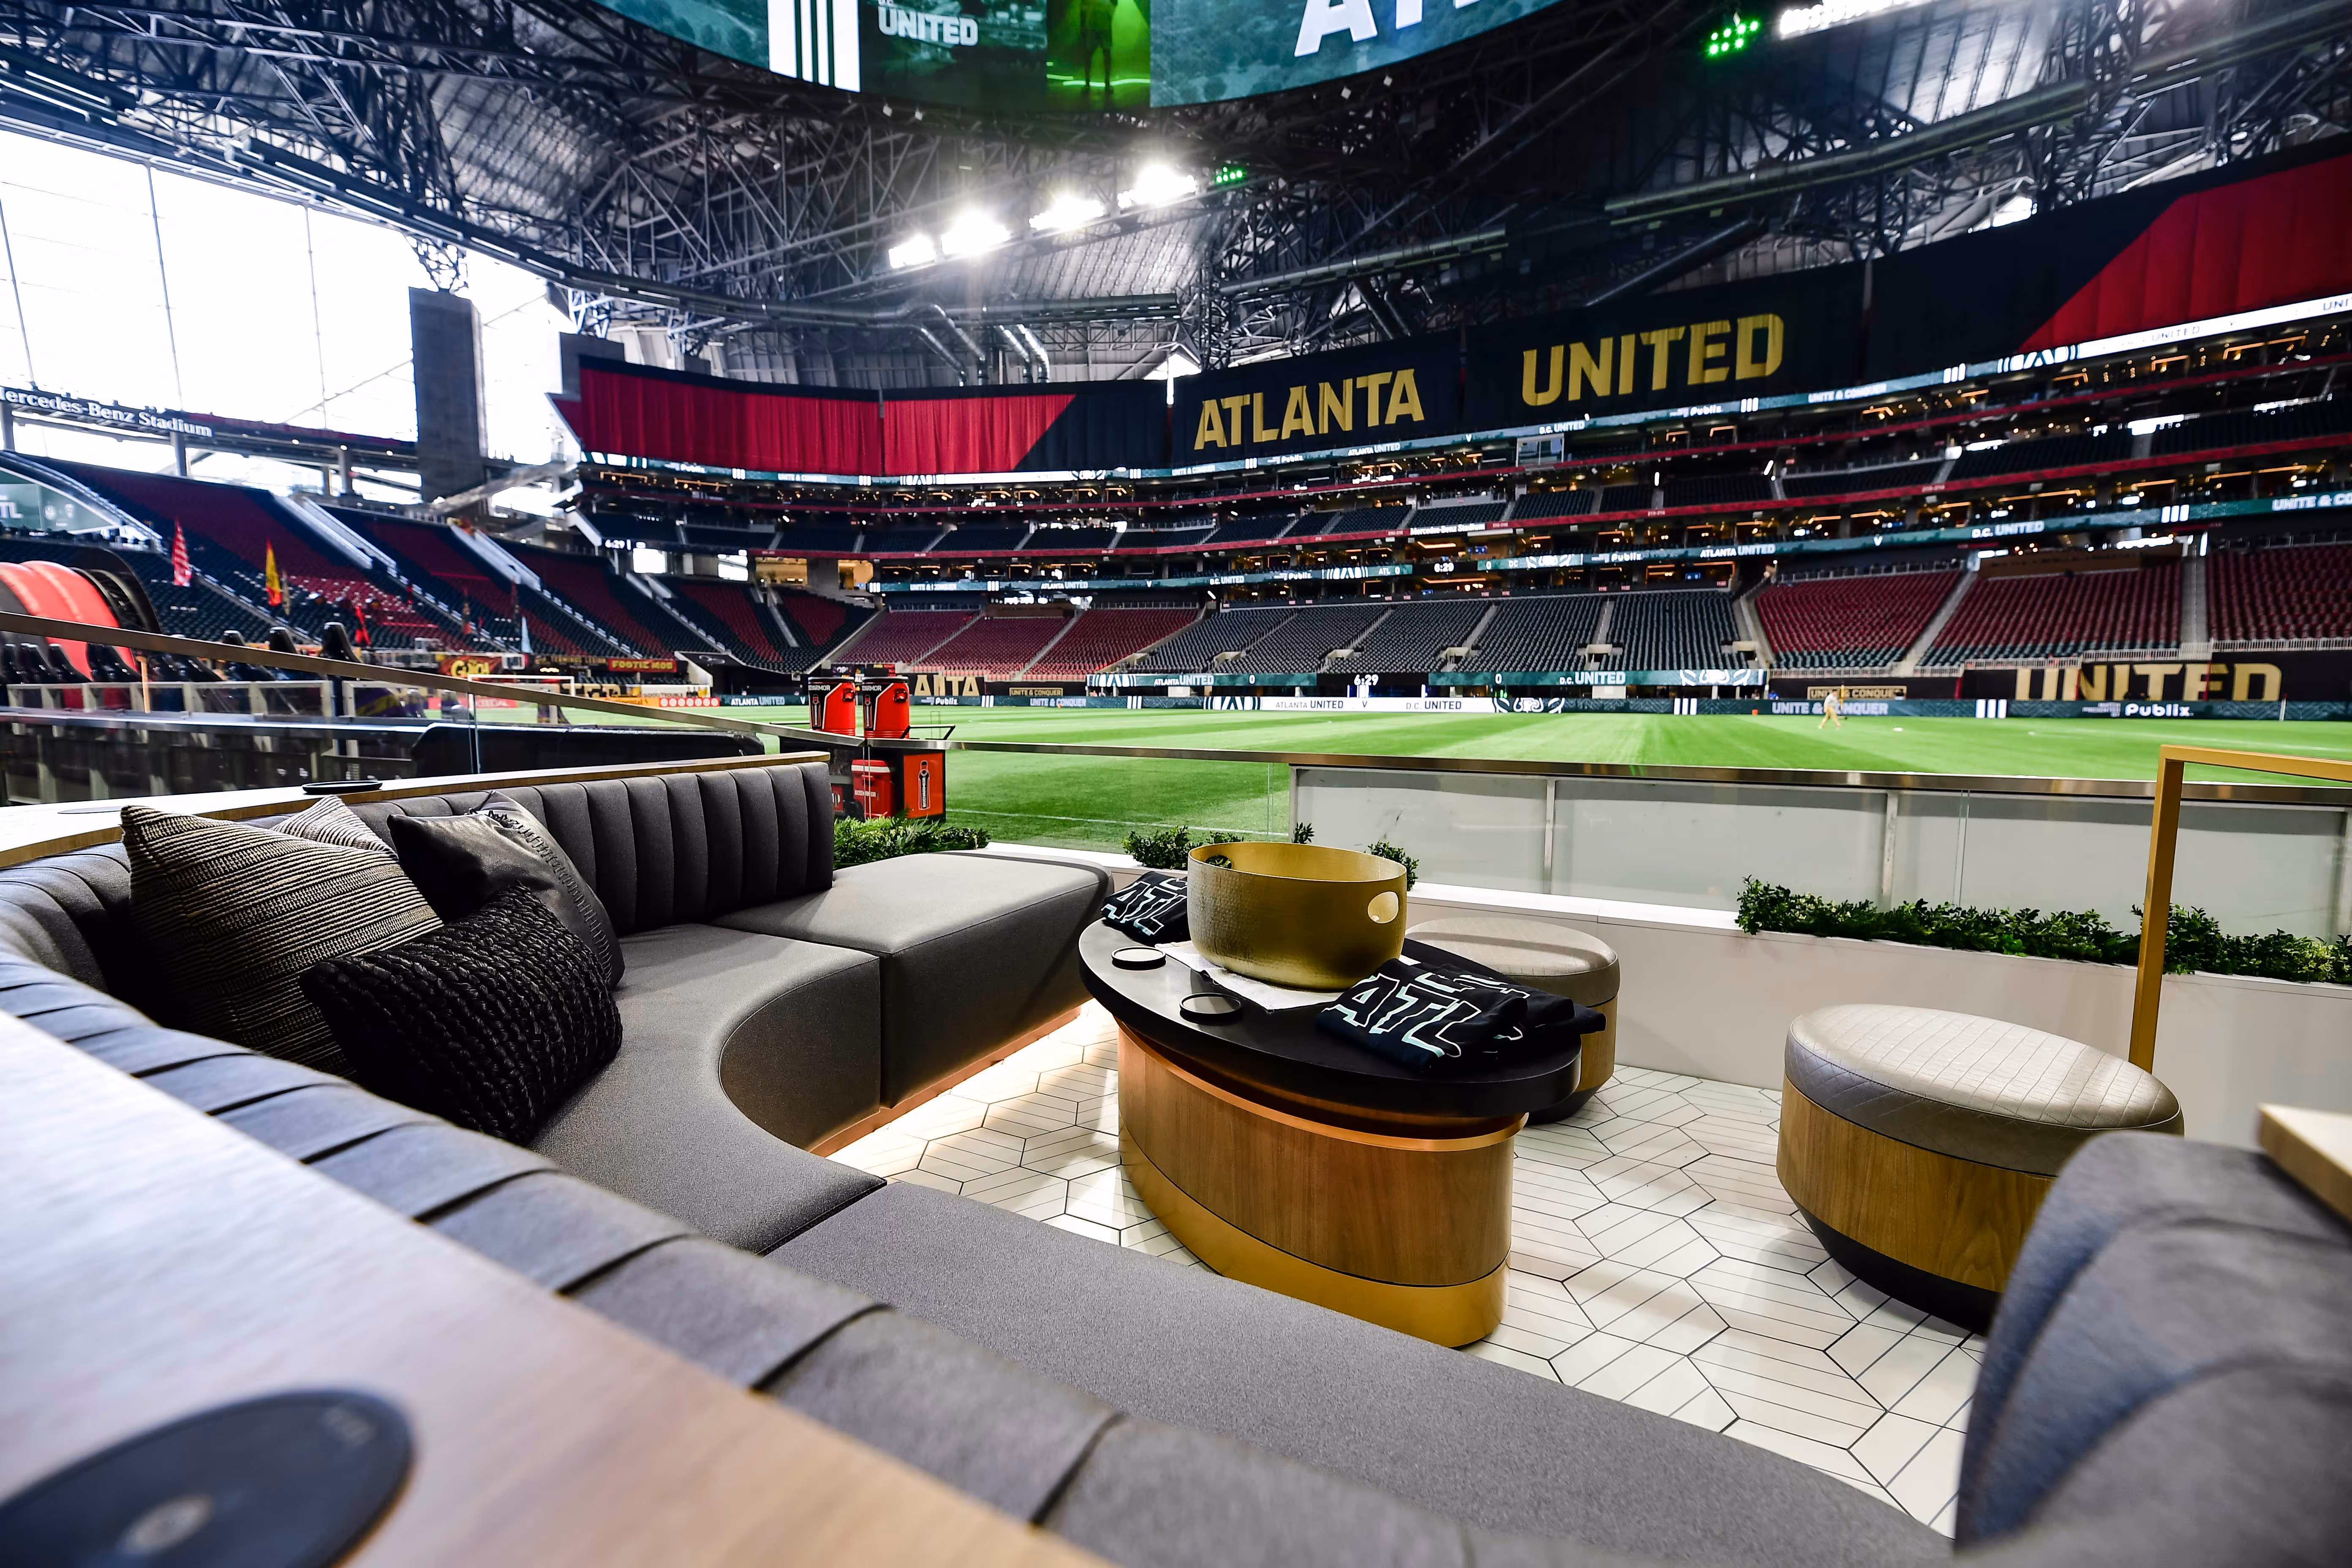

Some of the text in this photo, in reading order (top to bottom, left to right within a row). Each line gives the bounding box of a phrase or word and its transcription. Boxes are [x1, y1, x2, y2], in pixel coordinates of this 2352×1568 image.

[878, 6, 978, 46] UNITED
[2323, 297, 2352, 310] UNI
[1194, 313, 1784, 450] ATLANTA UNITED
[139, 411, 212, 437] Stadium
[1554, 420, 1585, 433] UNITED
[1348, 447, 1374, 456] ATLANTA
[1374, 443, 1400, 453] UNITED
[2272, 496, 2317, 511] UNITE
[1410, 525, 1456, 535] Mercedes-Benz
[1457, 523, 1485, 532] Stadium
[1971, 520, 2045, 538] D.C. UNITED
[1874, 536, 1883, 546] V
[1611, 552, 1642, 562] Publix
[1700, 543, 1776, 558] ATLANTA UNITED
[1434, 562, 1454, 572] 6:29
[1221, 575, 1244, 584] UNITED
[612, 660, 649, 669] FOOTIE
[1179, 675, 1214, 685] UNITED
[1249, 675, 1255, 684] 0
[1353, 674, 1379, 686] 6:29
[1495, 671, 1626, 685] 0 D.C. UNITED
[2015, 664, 2281, 701] UNITED
[759, 697, 785, 705] UNITED
[1030, 698, 1086, 707] UNITE & CONQUER
[1310, 700, 1344, 708] UNITED
[1425, 701, 1462, 710] UNITED
[1772, 702, 1889, 715] UNITE & ONQUER
[2125, 703, 2191, 717] Publix
[1101, 881, 1187, 936] ATL
[1321, 973, 1481, 1057] ATL
